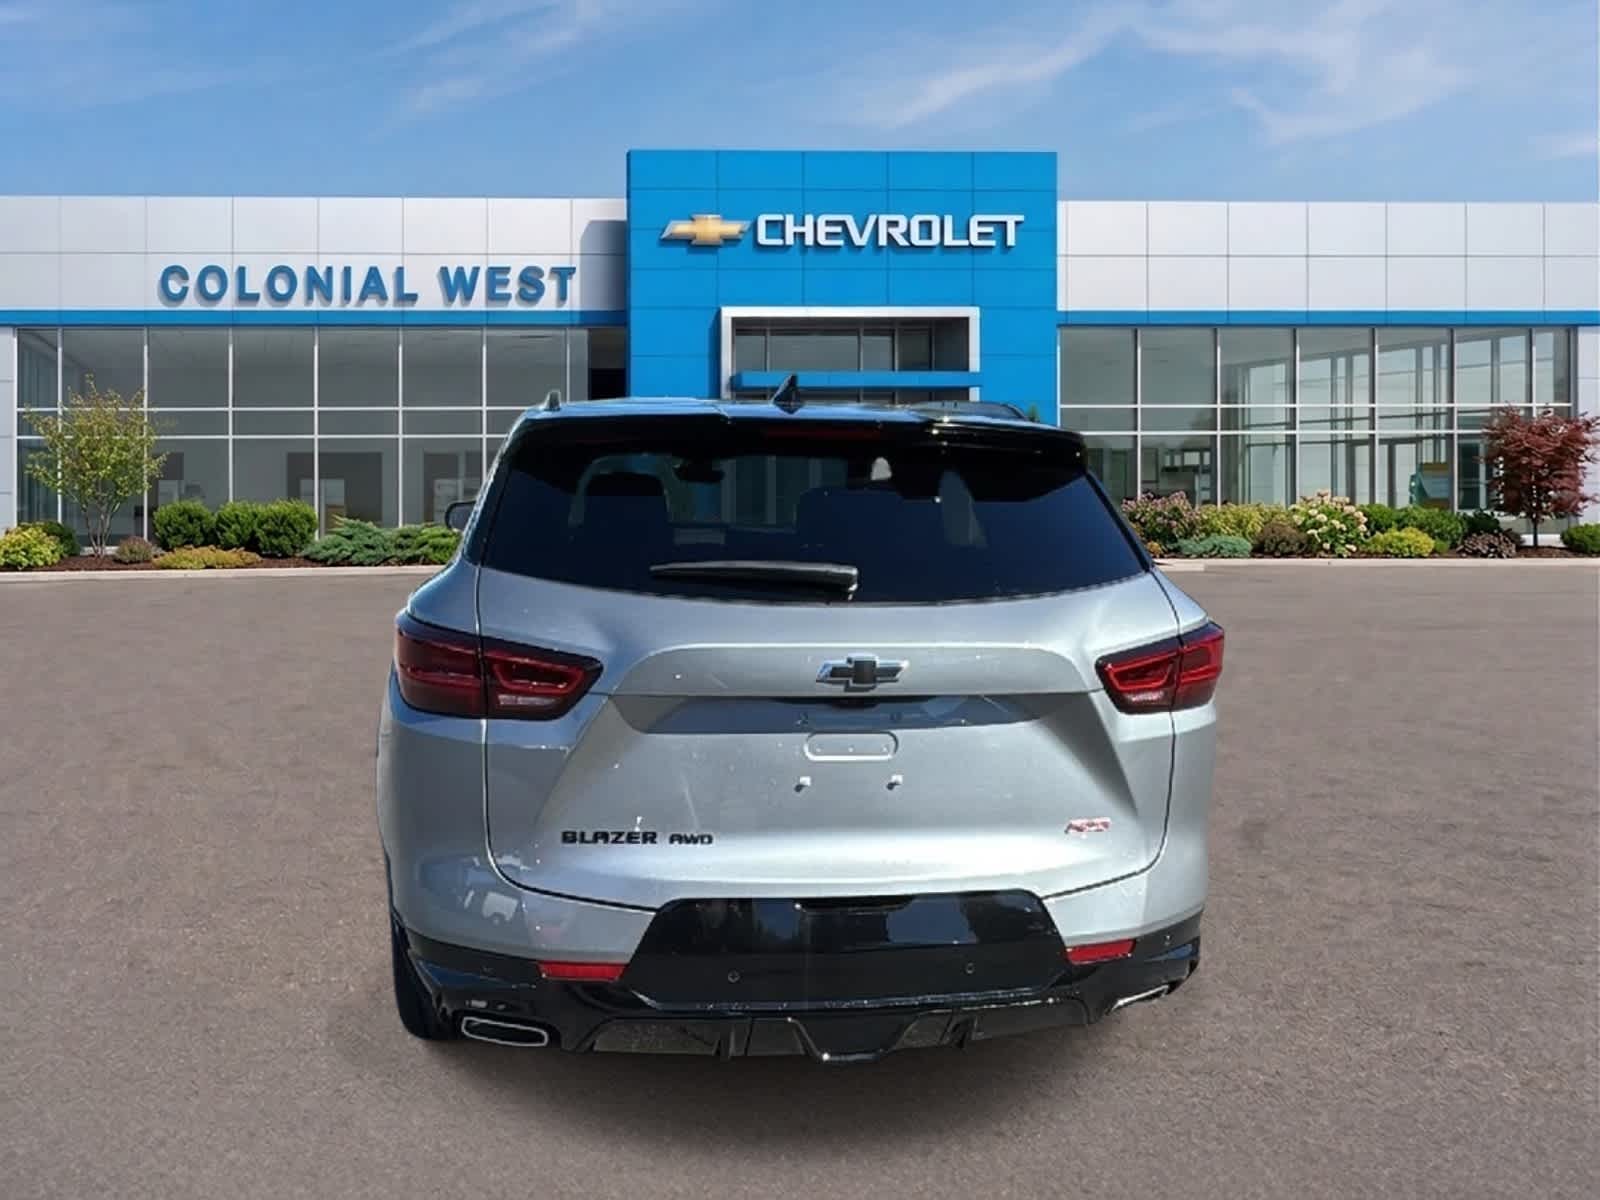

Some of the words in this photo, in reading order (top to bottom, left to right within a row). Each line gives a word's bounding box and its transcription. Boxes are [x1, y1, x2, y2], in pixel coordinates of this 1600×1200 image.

[757, 213, 1024, 247] CHEVROLET
[159, 264, 419, 304] COLONIAL
[438, 265, 577, 304] WEST
[561, 830, 658, 845] BLAZER
[668, 832, 714, 846] AWD
